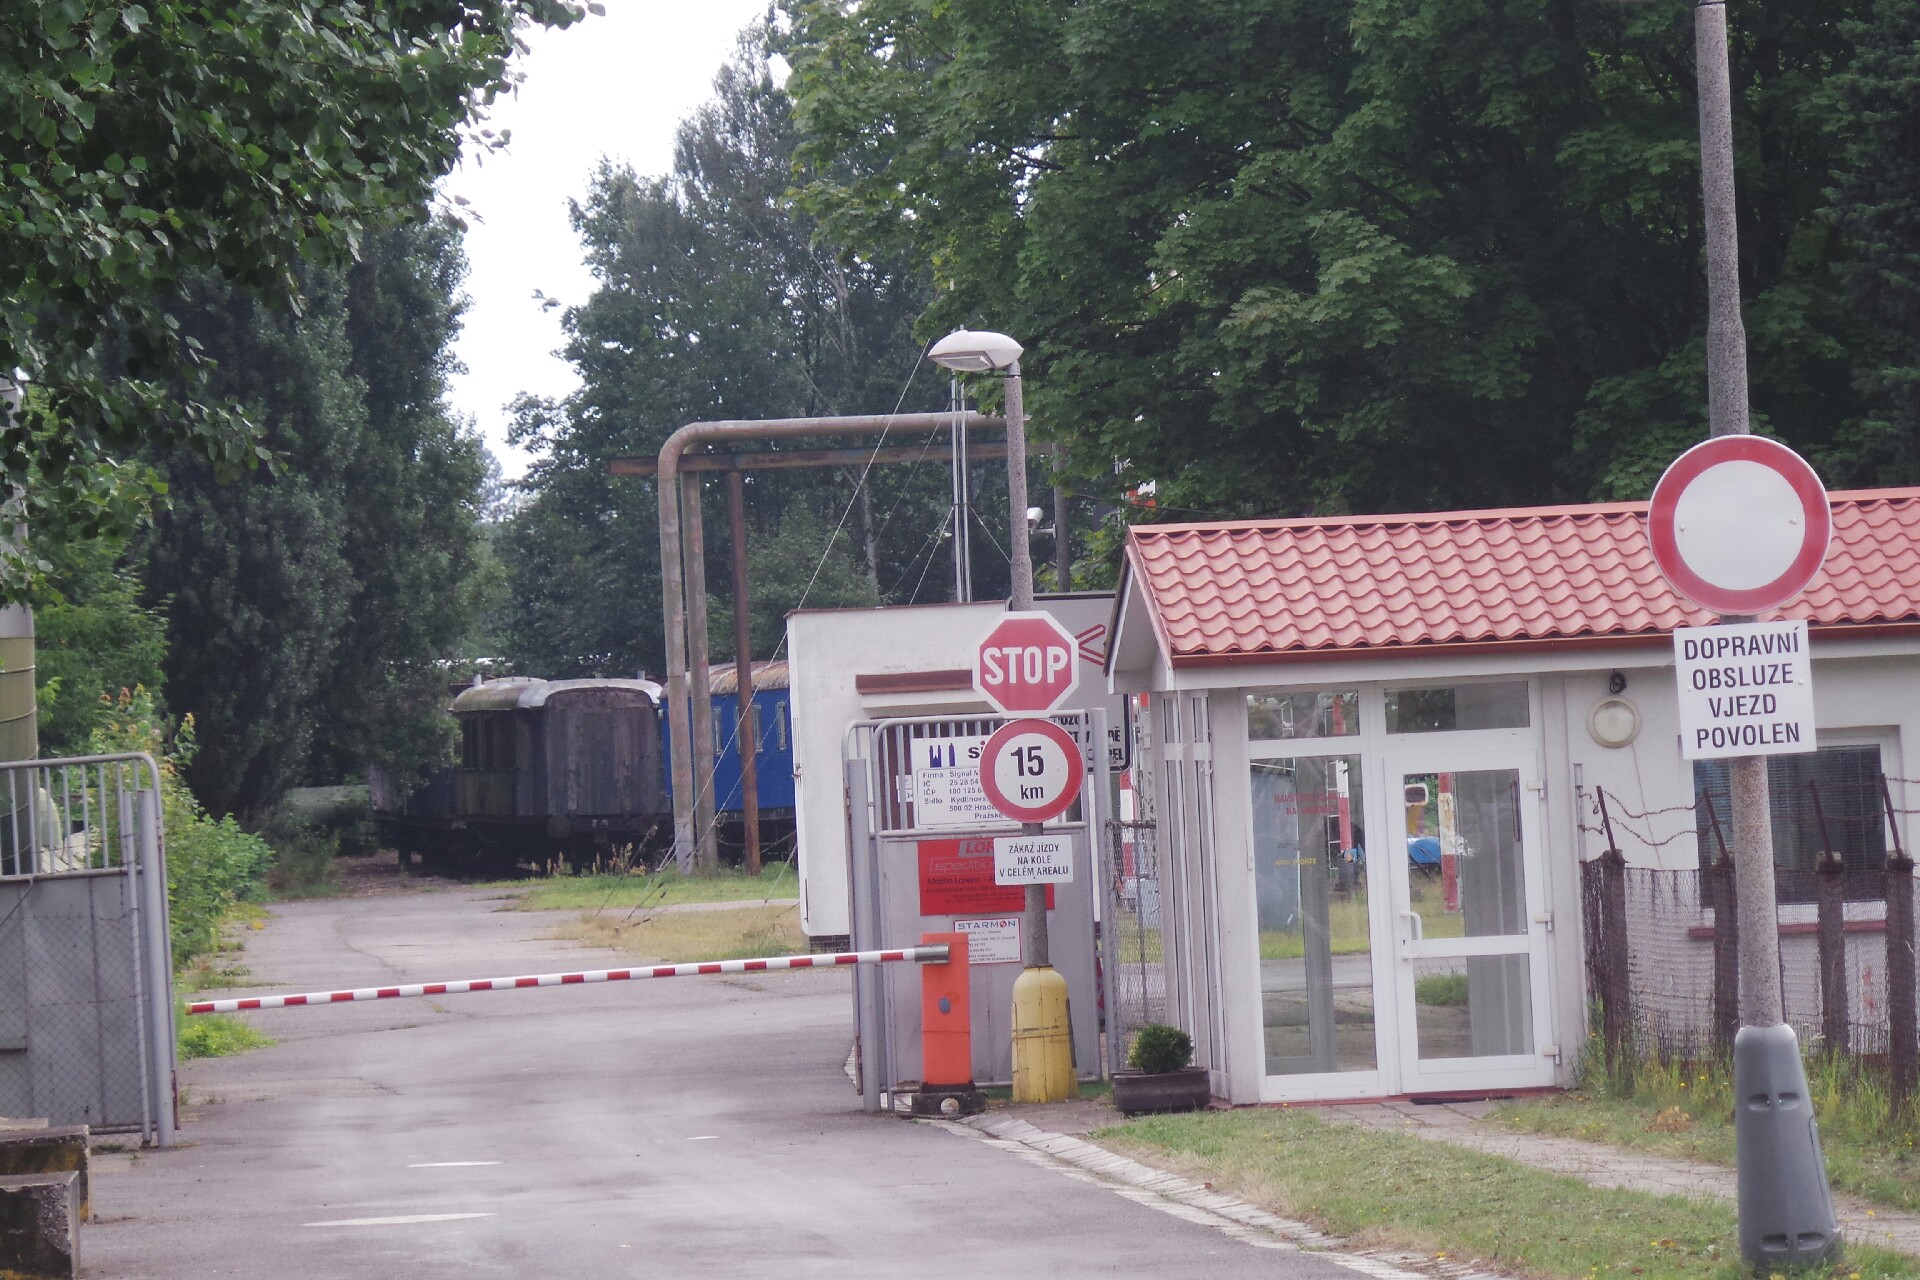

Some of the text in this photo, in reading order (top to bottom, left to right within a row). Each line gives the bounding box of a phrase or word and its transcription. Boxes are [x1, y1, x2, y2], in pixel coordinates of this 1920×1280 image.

[1684, 626, 1799, 660] DOPRAVNÍ
[983, 646, 1068, 685] STOP
[1692, 663, 1793, 690] OBSLUZE
[1708, 694, 1776, 717] VJEZD
[1697, 722, 1800, 749] POVOLEN
[1010, 746, 1044, 776] 15
[950, 770, 972, 778] Signal
[1020, 784, 1044, 800] km
[1036, 843, 1060, 853] JÍZDY
[1000, 864, 1068, 877] V CELÉM AREÁLU
[1018, 855, 1052, 865] NA KOLE
